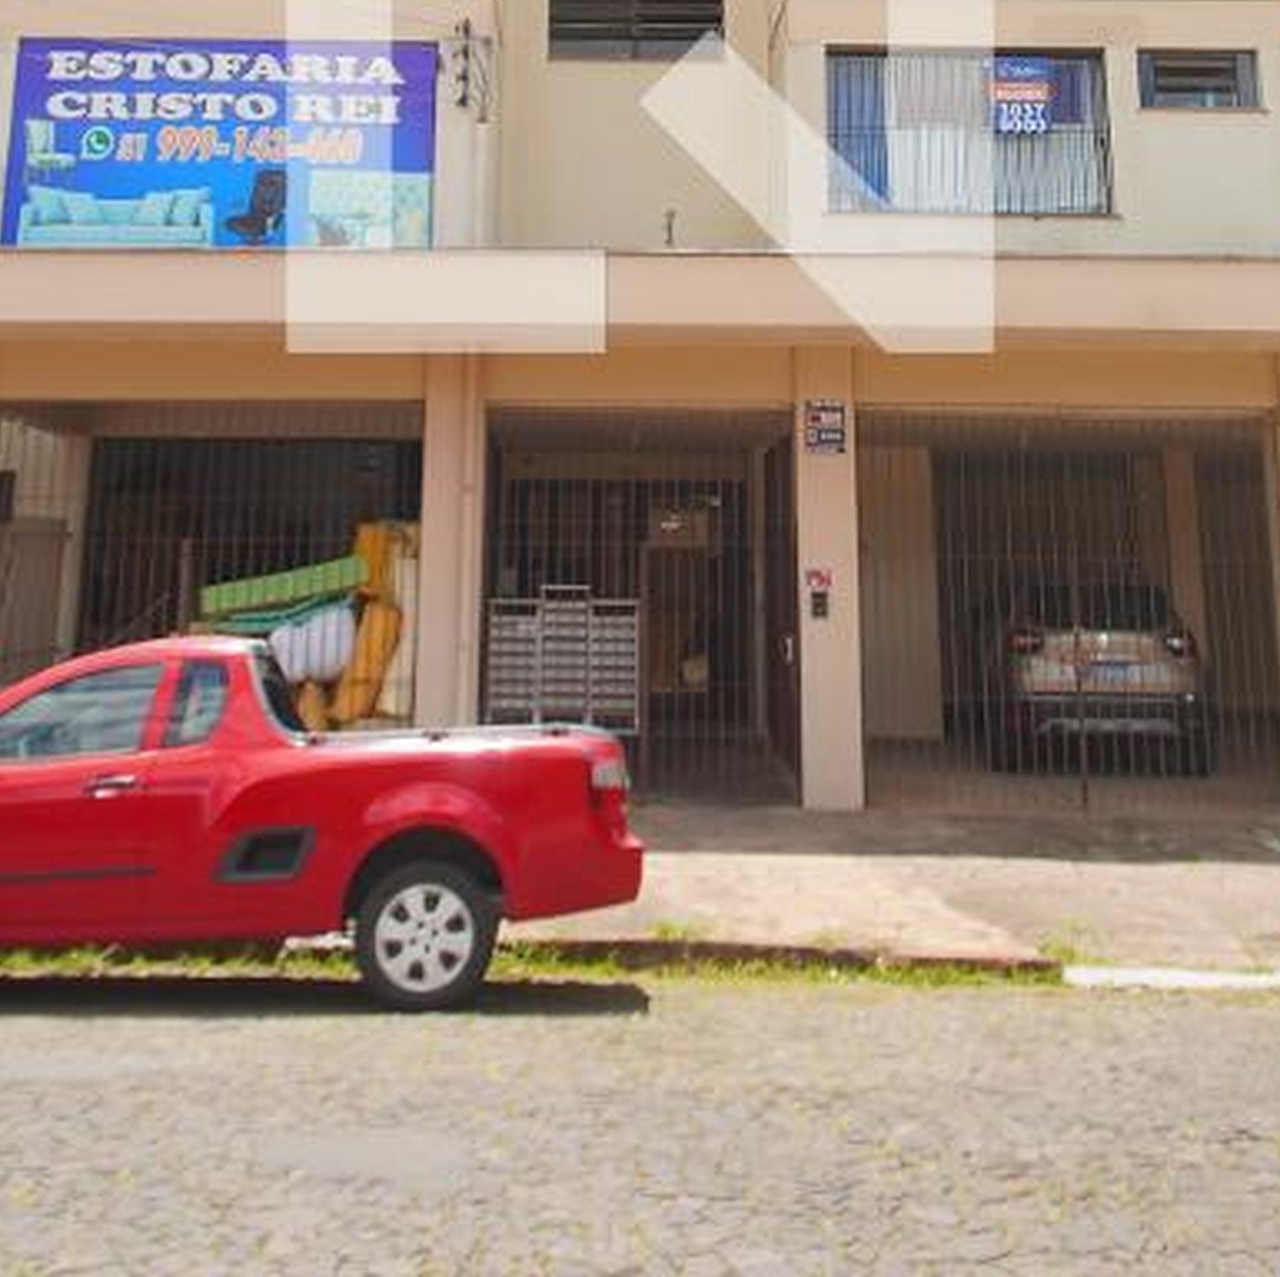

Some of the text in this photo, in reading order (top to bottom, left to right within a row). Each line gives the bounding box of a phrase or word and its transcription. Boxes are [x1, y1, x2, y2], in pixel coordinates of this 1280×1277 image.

[46, 50, 406, 85] ESTOFARIA
[46, 91, 402, 124] CRISTO REI
